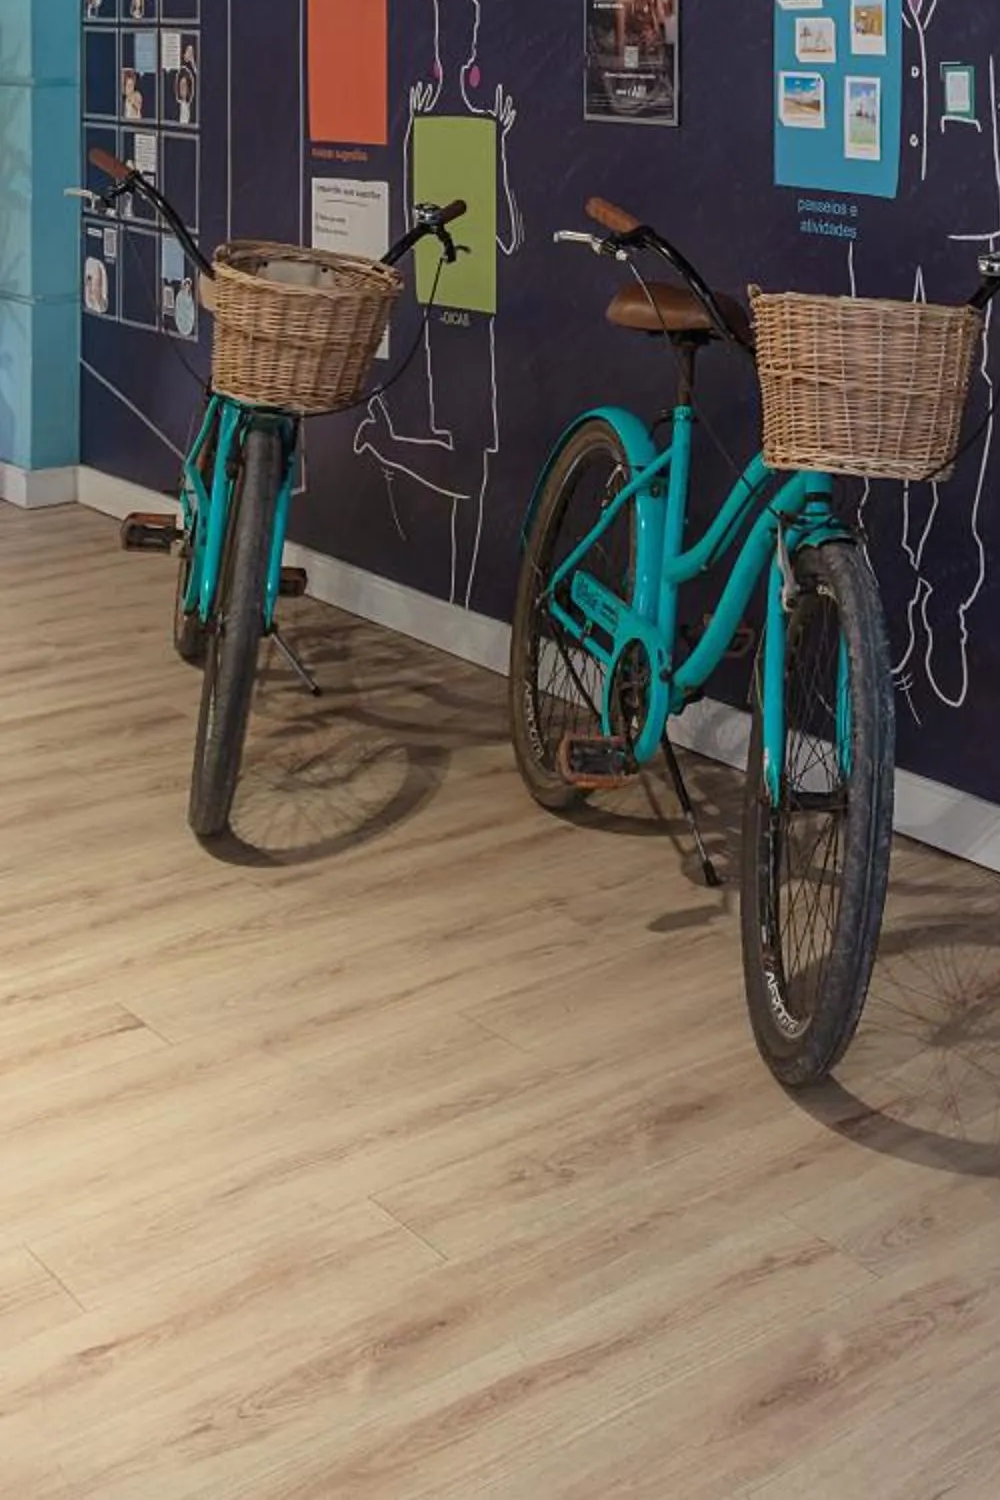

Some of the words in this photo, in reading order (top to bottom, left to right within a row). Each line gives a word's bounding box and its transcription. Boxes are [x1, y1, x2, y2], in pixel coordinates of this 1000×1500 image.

[797, 198, 847, 215] passeios
[850, 204, 858, 217] e
[800, 218, 857, 239] atividades
